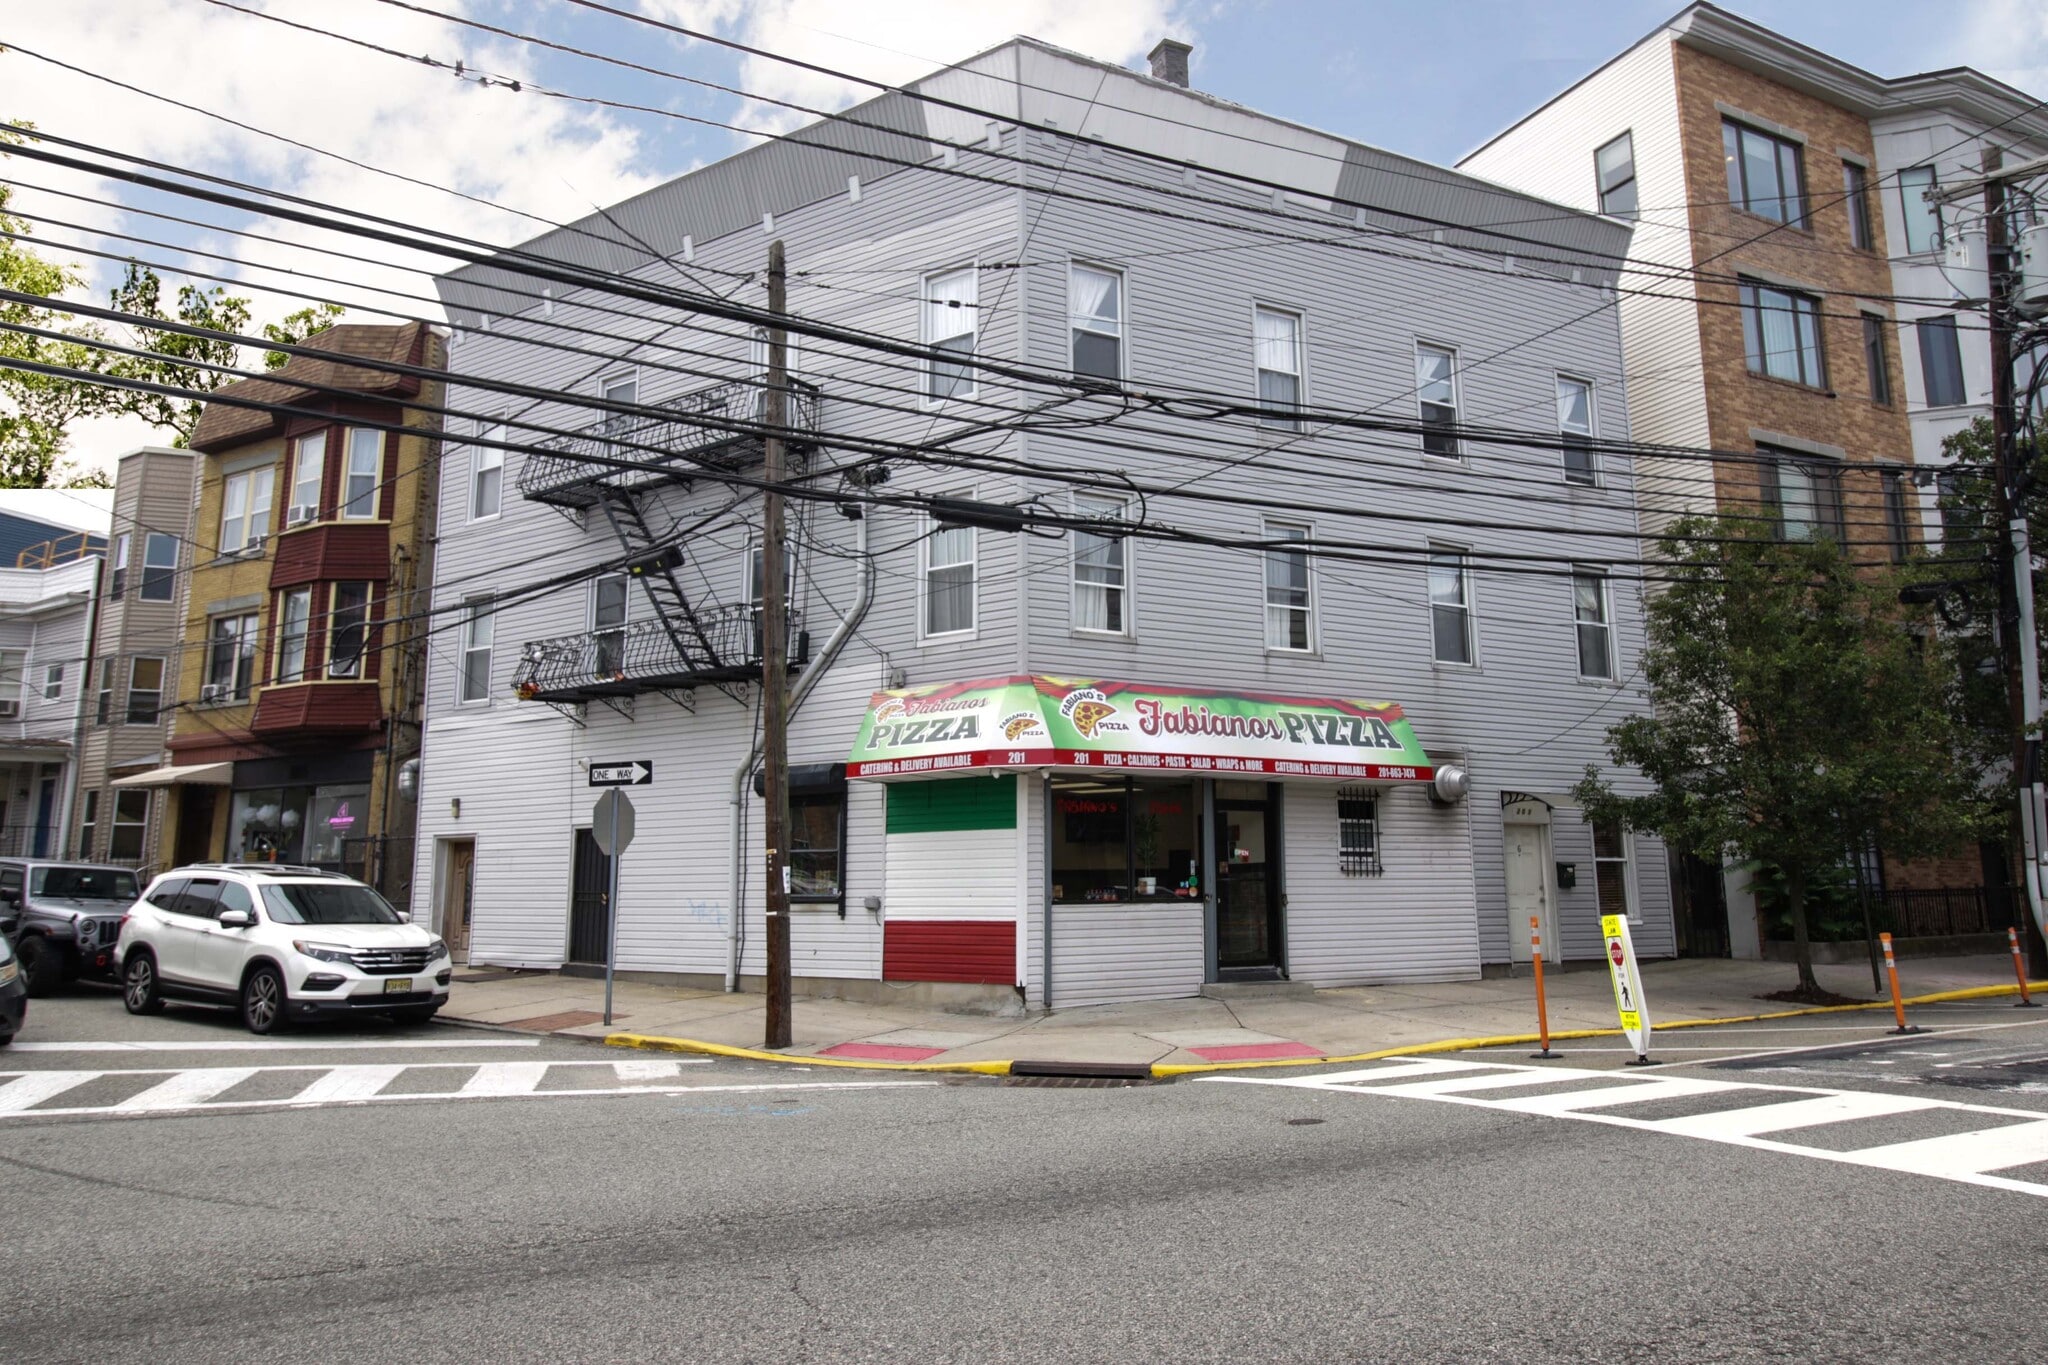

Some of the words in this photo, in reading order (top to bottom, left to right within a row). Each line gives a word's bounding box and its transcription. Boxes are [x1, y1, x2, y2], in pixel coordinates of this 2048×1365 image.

[907, 696, 988, 716] Fabianos
[1000, 712, 1035, 729] FABIANOS
[1098, 722, 1130, 731] PIZZA
[1135, 699, 1284, 739] Fabianos
[1278, 711, 1402, 750] PIZZA
[866, 714, 979, 749] PIZZA
[860, 762, 893, 775] CATERING
[894, 763, 900, 772] &
[901, 758, 933, 771] DELIVERY
[934, 754, 972, 769] AVAILABLE
[1008, 751, 1026, 764] 201
[1074, 752, 1089, 764] 201
[1103, 753, 1122, 766] PIZZA
[1127, 754, 1160, 767] CALZONES
[1165, 756, 1186, 768] PASTA
[1190, 757, 1211, 769] SALAD
[1215, 758, 1239, 770] WRAPS
[1245, 760, 1264, 772] MORE
[593, 769, 609, 780] ONE
[617, 769, 633, 779] WAY
[1274, 761, 1304, 774] CATERING
[1309, 763, 1336, 776] DELIVERY
[1337, 765, 1367, 777] AVAILABLE
[1234, 848, 1249, 857] OPEN
[1611, 949, 1624, 959] STOP
